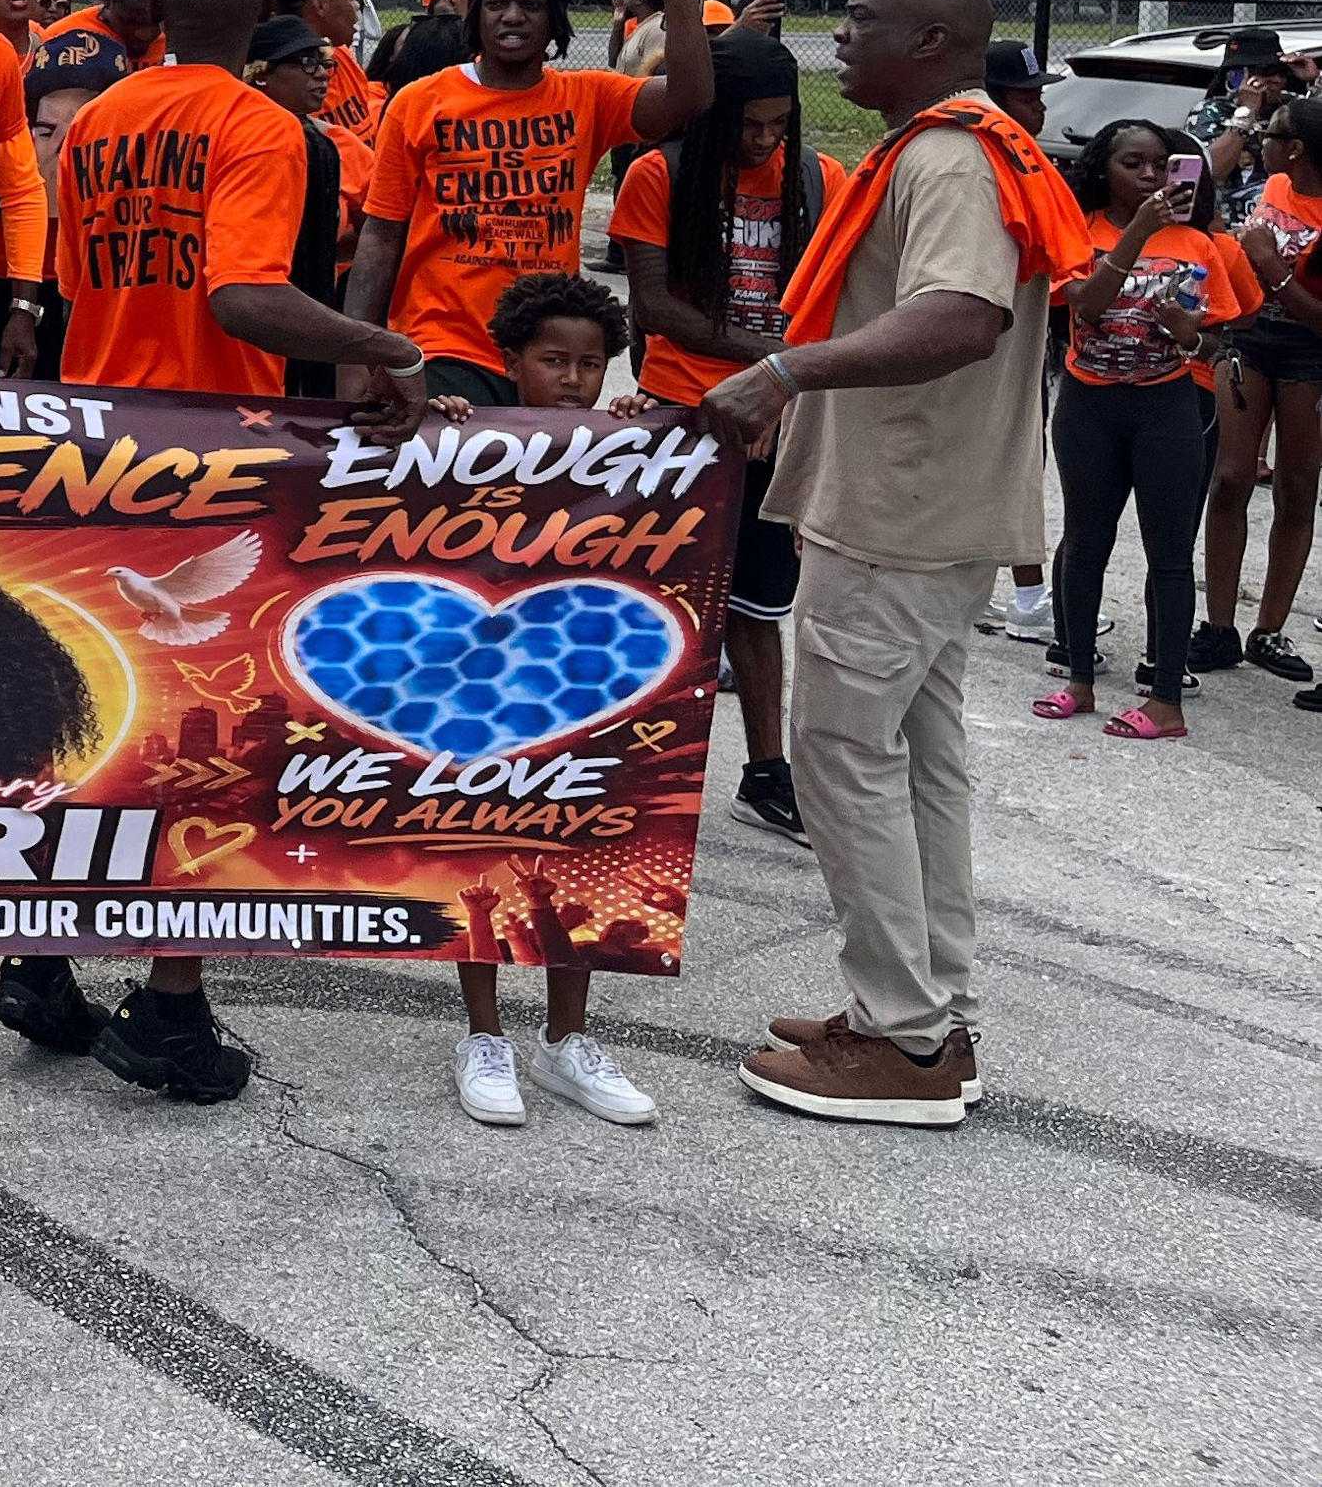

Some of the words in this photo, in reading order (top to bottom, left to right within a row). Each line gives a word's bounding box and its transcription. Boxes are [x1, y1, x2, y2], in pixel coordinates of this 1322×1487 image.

[434, 109, 575, 152] ENOUGH
[491, 151, 524, 169] IS
[436, 158, 575, 206] ENOUGH
[114, 195, 152, 226] OUR
[485, 217, 541, 229] COMMUNITY
[732, 216, 782, 248] GUN
[482, 228, 514, 240] PEACE
[515, 228, 545, 240] WALK
[318, 424, 720, 500] ENOUGH
[458, 483, 524, 509] IS
[287, 495, 707, 573] ENOUGH
[275, 747, 406, 795] WE
[408, 749, 624, 801] LOVE
[270, 796, 377, 834] YOU
[394, 797, 638, 839] ALWAYS
[94, 899, 422, 945] COMMUNITIES.
